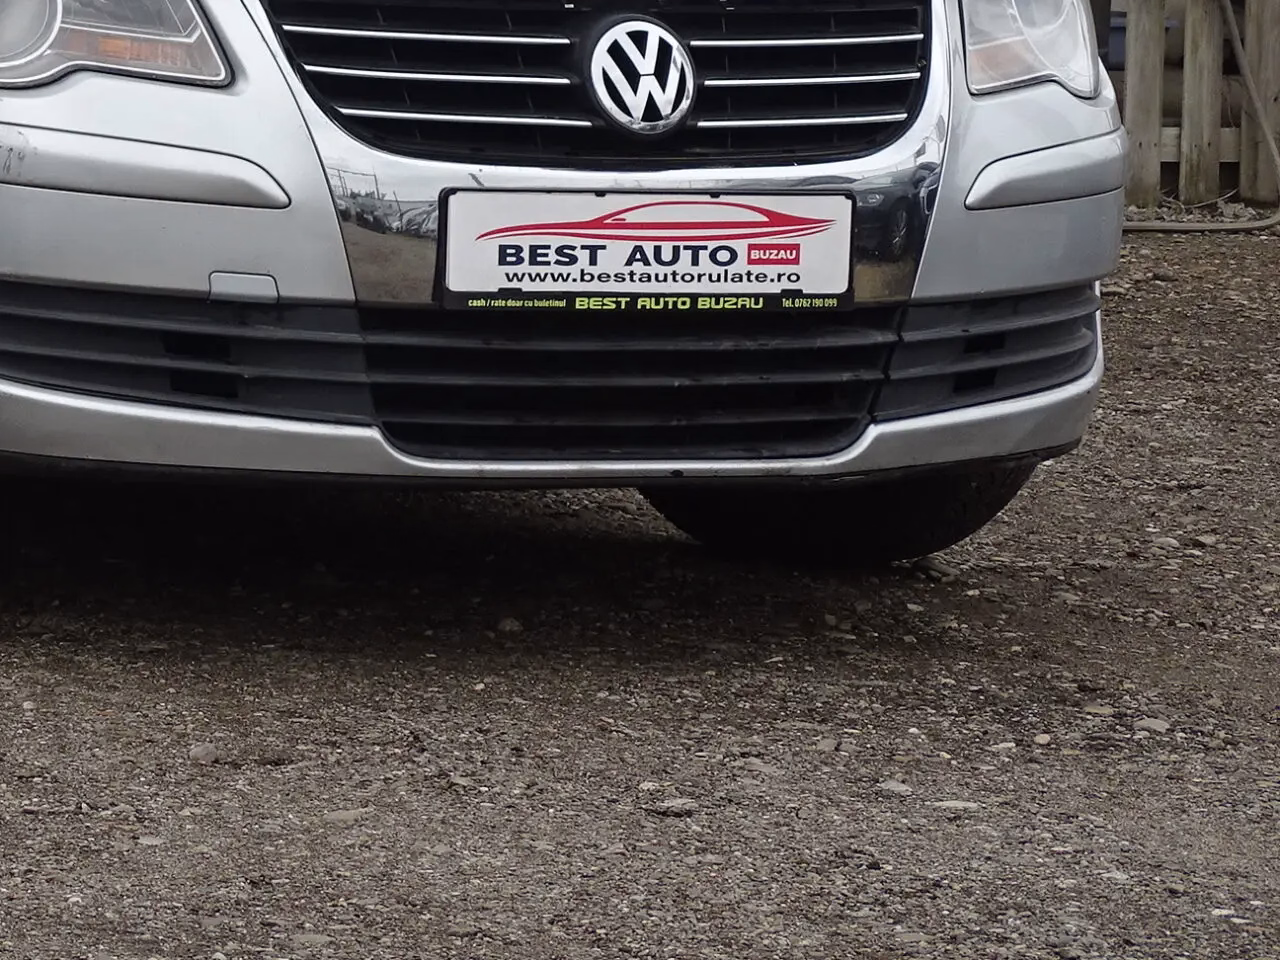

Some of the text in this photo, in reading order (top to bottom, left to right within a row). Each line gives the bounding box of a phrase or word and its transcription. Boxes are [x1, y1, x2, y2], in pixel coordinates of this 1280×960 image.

[497, 243, 797, 267] BEST AUTO BUZAU
[504, 268, 801, 285] www.bestautorulate.ro
[468, 298, 486, 307] cash
[491, 298, 506, 307] rate
[506, 298, 524, 307] doar
[524, 299, 533, 307] cu
[534, 298, 567, 307] buletinul
[575, 296, 764, 310] BEST AUTO BUZAU
[782, 298, 794, 307] Tel.
